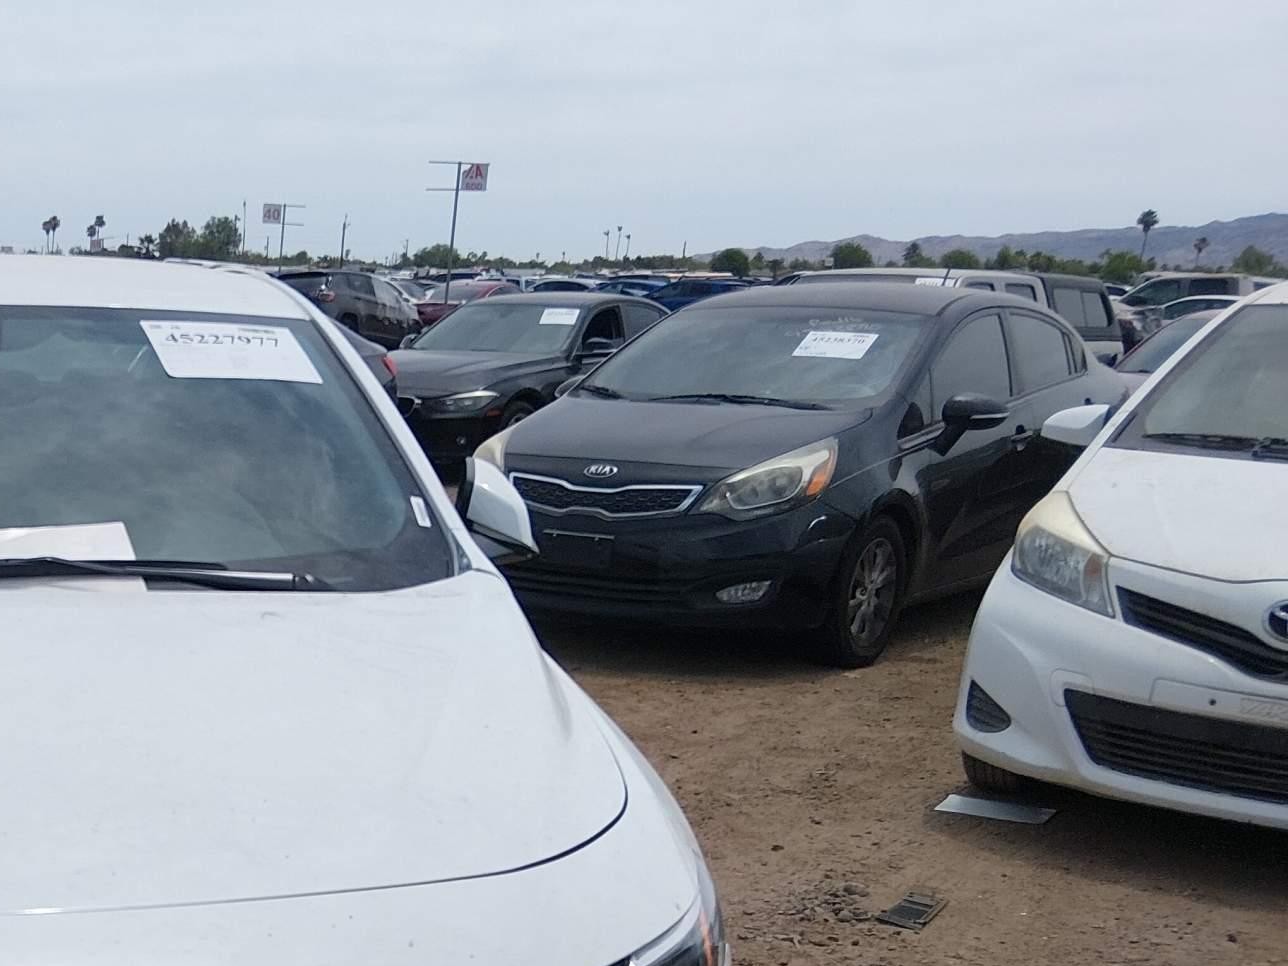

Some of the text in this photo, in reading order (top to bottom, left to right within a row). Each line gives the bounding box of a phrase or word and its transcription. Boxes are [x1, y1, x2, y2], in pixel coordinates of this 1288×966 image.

[263, 208, 280, 220] 40
[165, 333, 279, 348] 45227977
[587, 464, 613, 475] KIA
